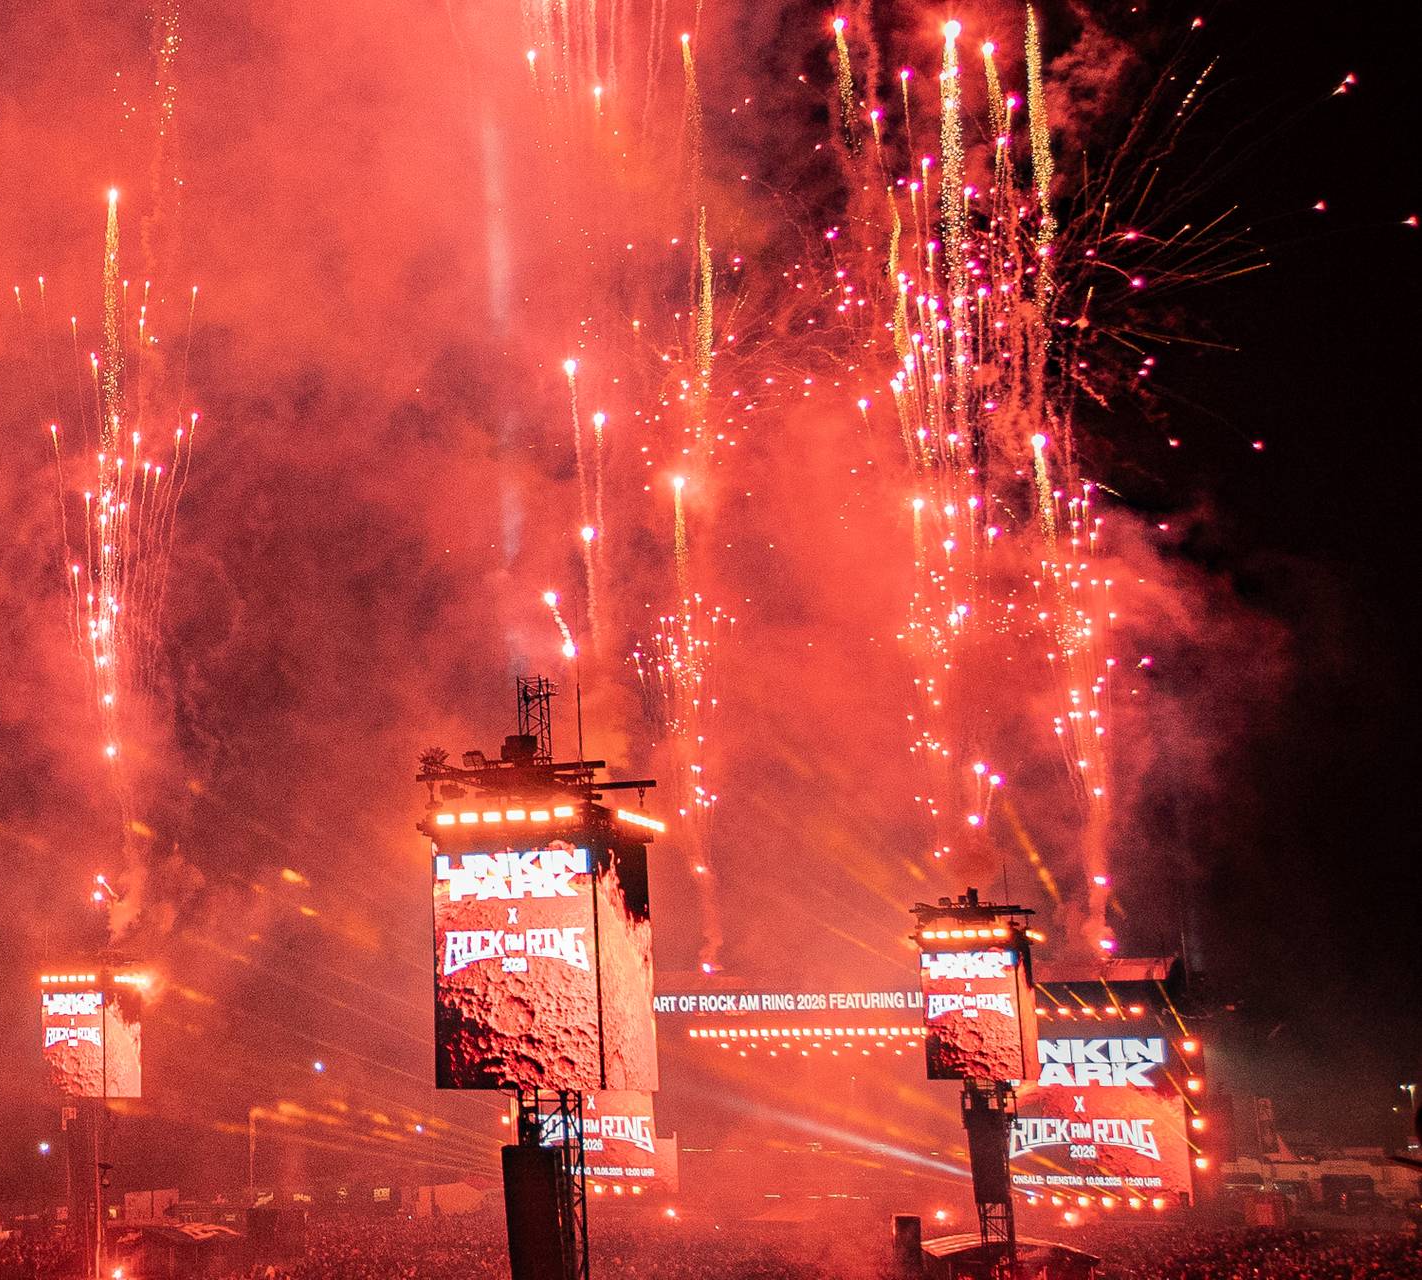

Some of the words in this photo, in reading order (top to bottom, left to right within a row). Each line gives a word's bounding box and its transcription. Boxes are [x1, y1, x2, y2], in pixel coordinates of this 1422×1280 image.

[436, 849, 587, 880] LINKIN
[449, 875, 578, 901] PARK
[507, 907, 518, 924] X
[444, 930, 506, 976] ROCK
[526, 928, 590, 971] RING
[921, 952, 1011, 968] LINKIN
[930, 962, 1007, 979] PARK
[653, 996, 676, 1011] ART
[679, 996, 697, 1011] OF
[699, 995, 736, 1011] ROCK
[739, 995, 758, 1010] AM
[761, 994, 794, 1011] RING
[797, 994, 826, 1009] 2026
[829, 992, 904, 1009] FEATURING
[907, 992, 923, 1008] LI
[928, 994, 964, 1019] ROCK
[976, 993, 1015, 1017] RING
[1037, 1039, 1163, 1063] NKIN
[1038, 1063, 1155, 1086] ARK
[586, 1095, 595, 1109] X
[1073, 1096, 1085, 1112] X
[583, 1119, 599, 1132] AM
[601, 1115, 655, 1153] RING
[1009, 1118, 1071, 1159] ROCK
[1071, 1123, 1091, 1138] AM
[1092, 1118, 1161, 1161] RING
[583, 1139, 603, 1150] 2026
[1070, 1145, 1096, 1158] 2026
[1125, 1177, 1143, 1187] 12:00
[1144, 1177, 1161, 1187] UHR
